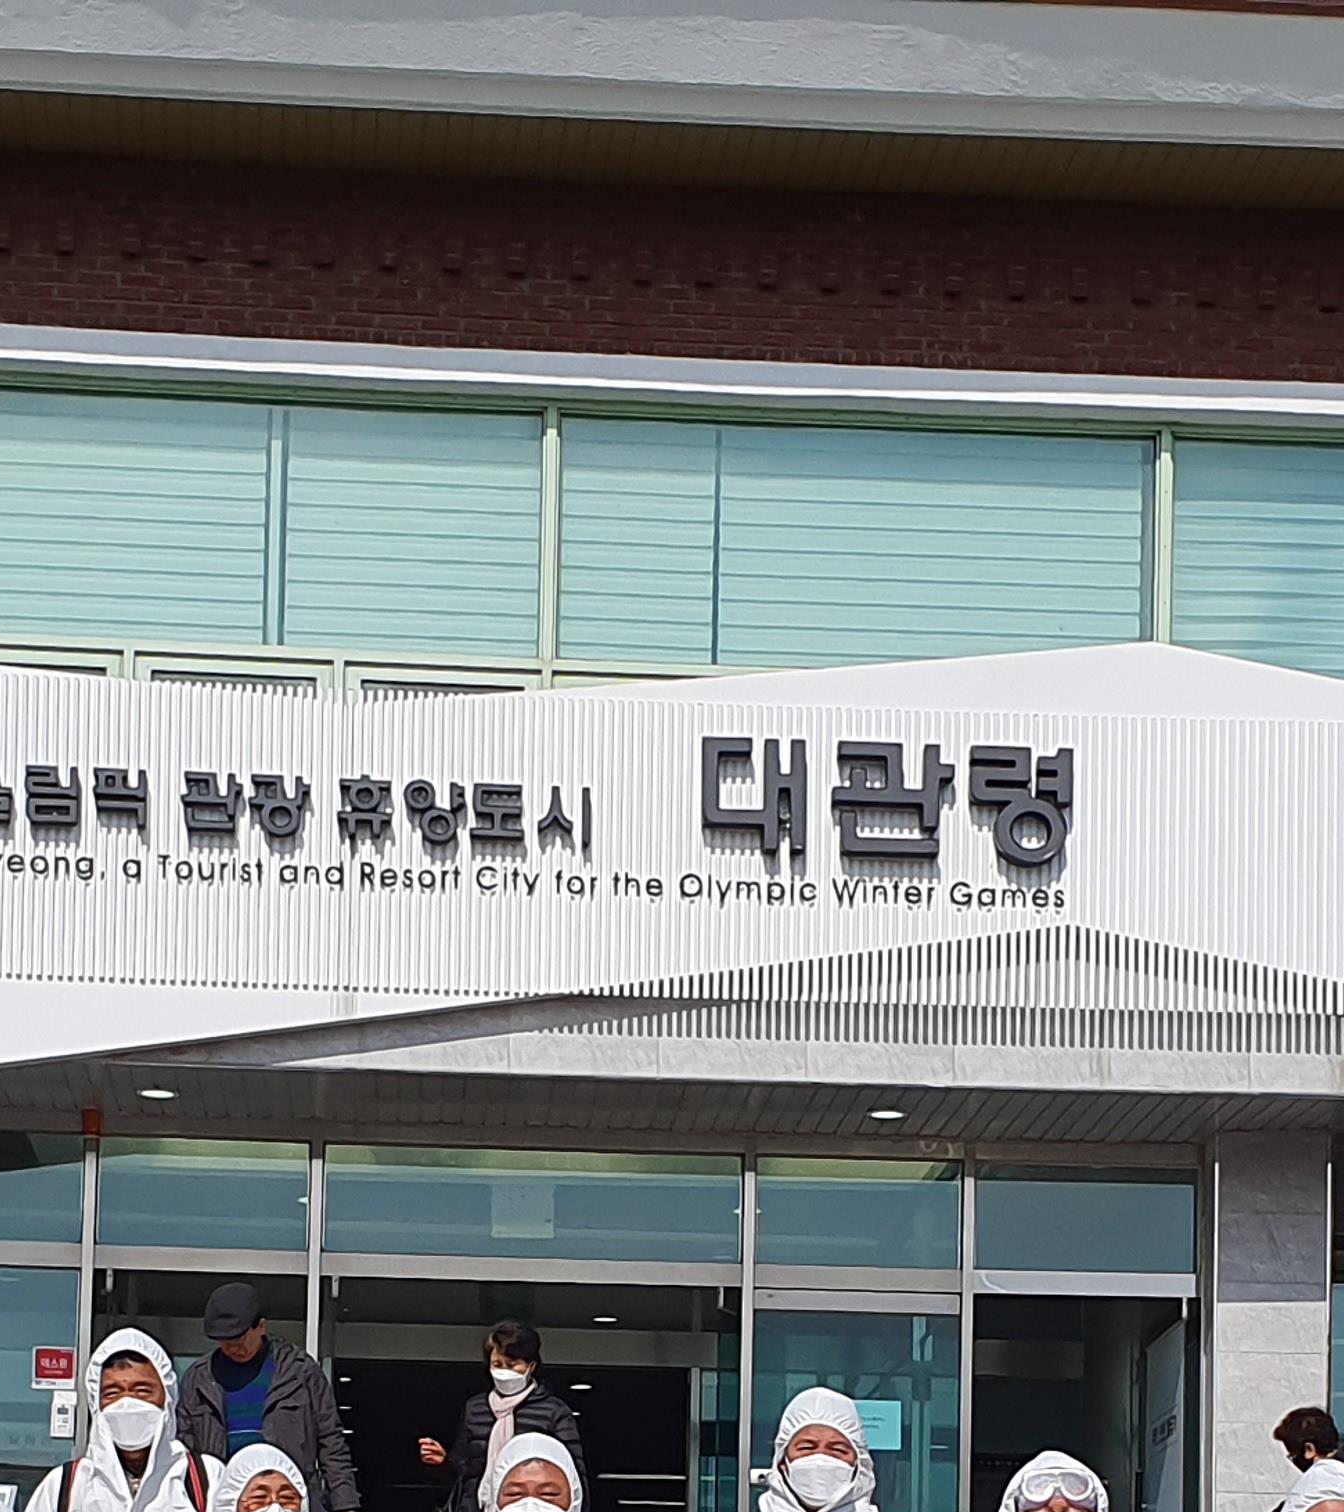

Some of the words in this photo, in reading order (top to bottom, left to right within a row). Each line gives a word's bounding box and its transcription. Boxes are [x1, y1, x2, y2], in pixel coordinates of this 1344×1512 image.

[180, 770, 311, 837] 관광
[337, 774, 592, 850] 휴양도시
[701, 736, 1074, 867] 대관령
[122, 859, 142, 880] a
[157, 854, 264, 883] Tourist
[279, 861, 345, 886] and
[360, 862, 461, 890] Resort
[475, 865, 540, 896] City
[555, 870, 599, 897] for
[611, 871, 664, 898] the
[678, 872, 818, 908] Olympic
[831, 877, 937, 908] Winter
[949, 881, 1066, 910] Games
